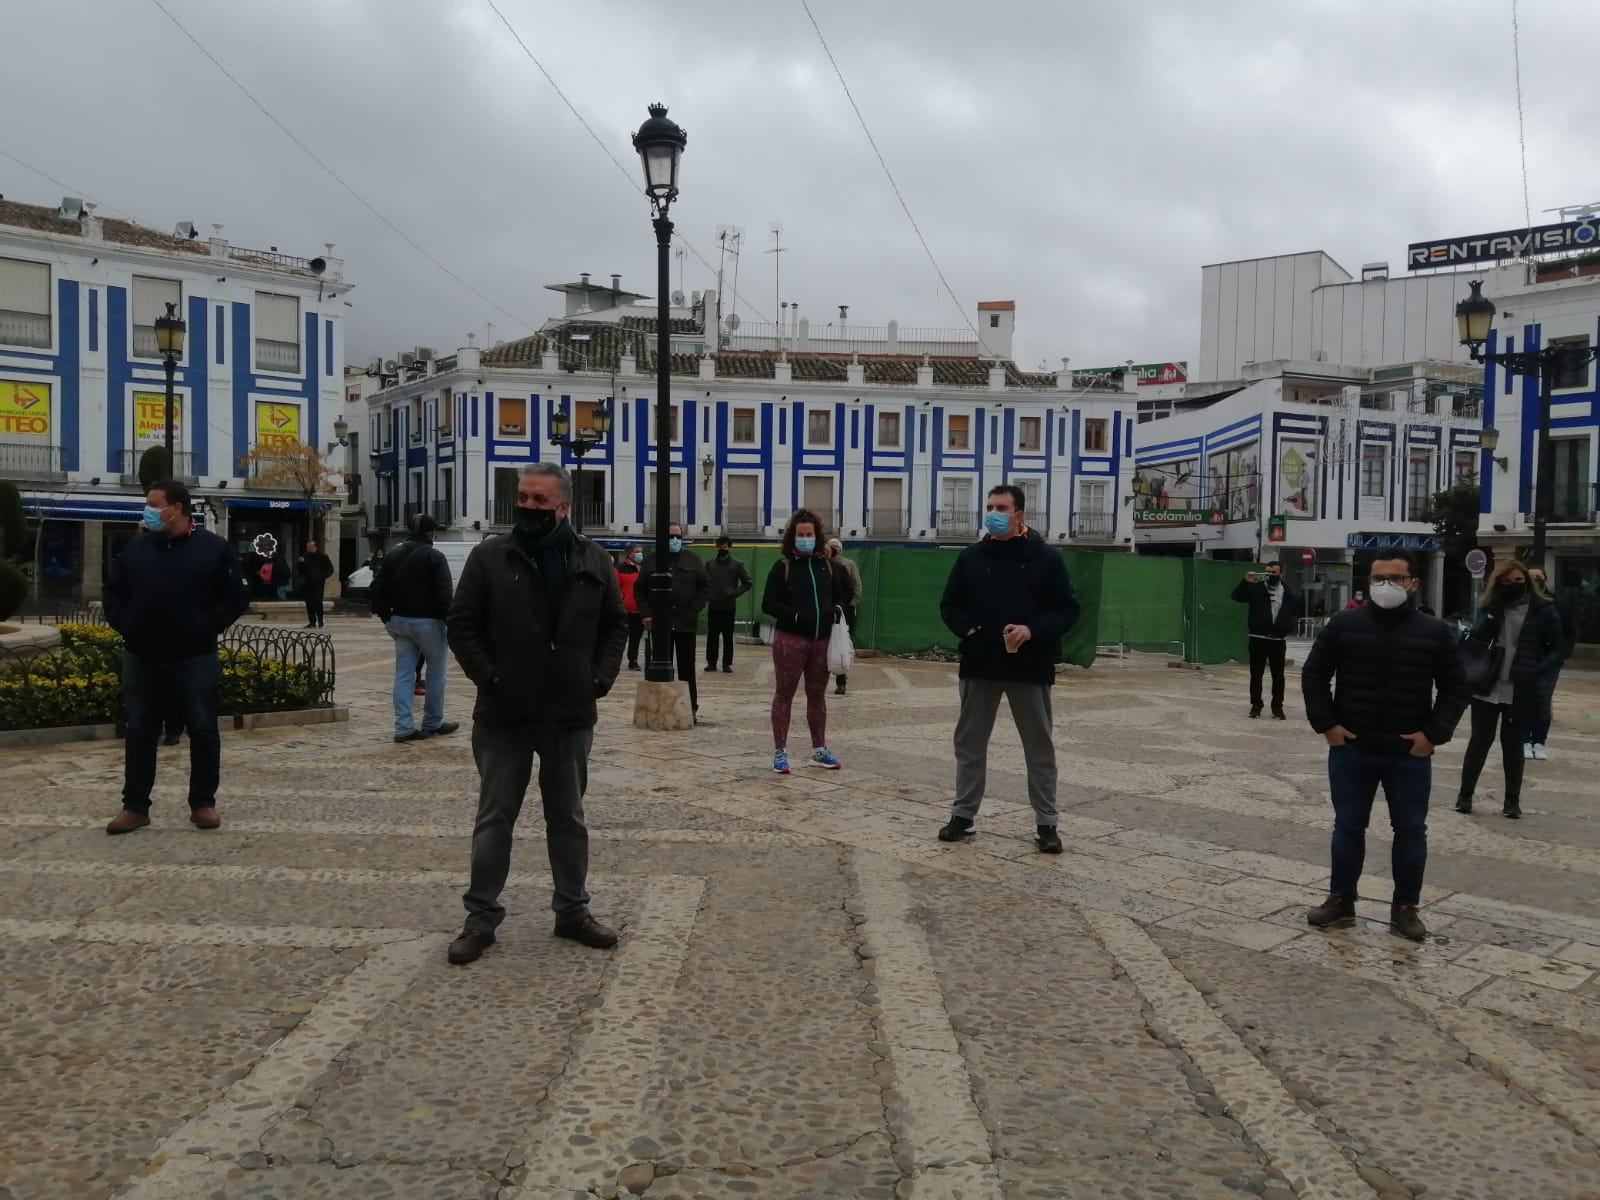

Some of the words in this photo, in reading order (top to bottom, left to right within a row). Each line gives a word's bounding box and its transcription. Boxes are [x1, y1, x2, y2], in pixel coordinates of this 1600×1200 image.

[1409, 218, 1600, 265] RENTAVISIÓ
[138, 402, 179, 419] TEO
[0, 414, 47, 433] TEO
[139, 420, 179, 431] Alqua
[1142, 510, 1202, 521] Ecofamilia
